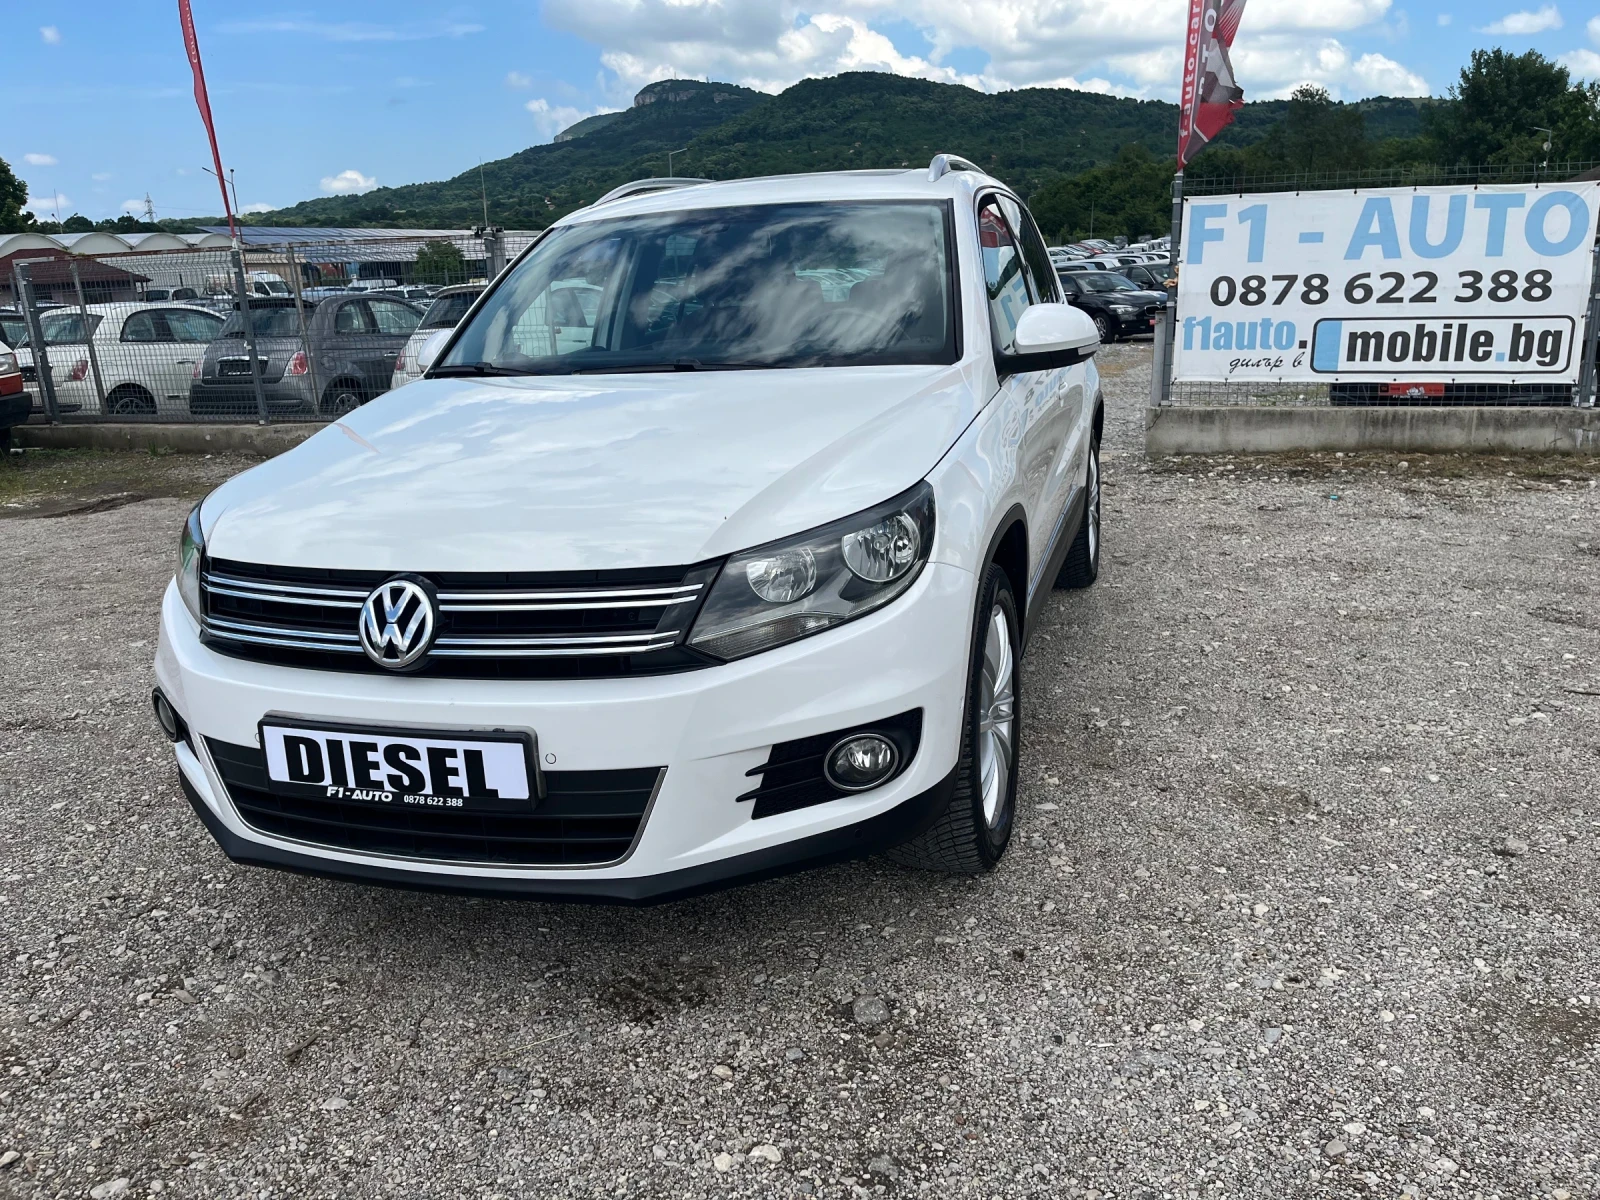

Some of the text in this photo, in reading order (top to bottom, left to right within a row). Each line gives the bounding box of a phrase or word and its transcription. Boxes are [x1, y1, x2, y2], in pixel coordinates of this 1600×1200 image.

[1186, 191, 1590, 265] F1 - AUTO
[1210, 269, 1553, 306] 0878 622 388
[1346, 323, 1562, 366] mobile.bg
[283, 735, 499, 798] DIESEL
[326, 786, 393, 802] F1-AUTO
[403, 795, 463, 807] 0878 622 388
